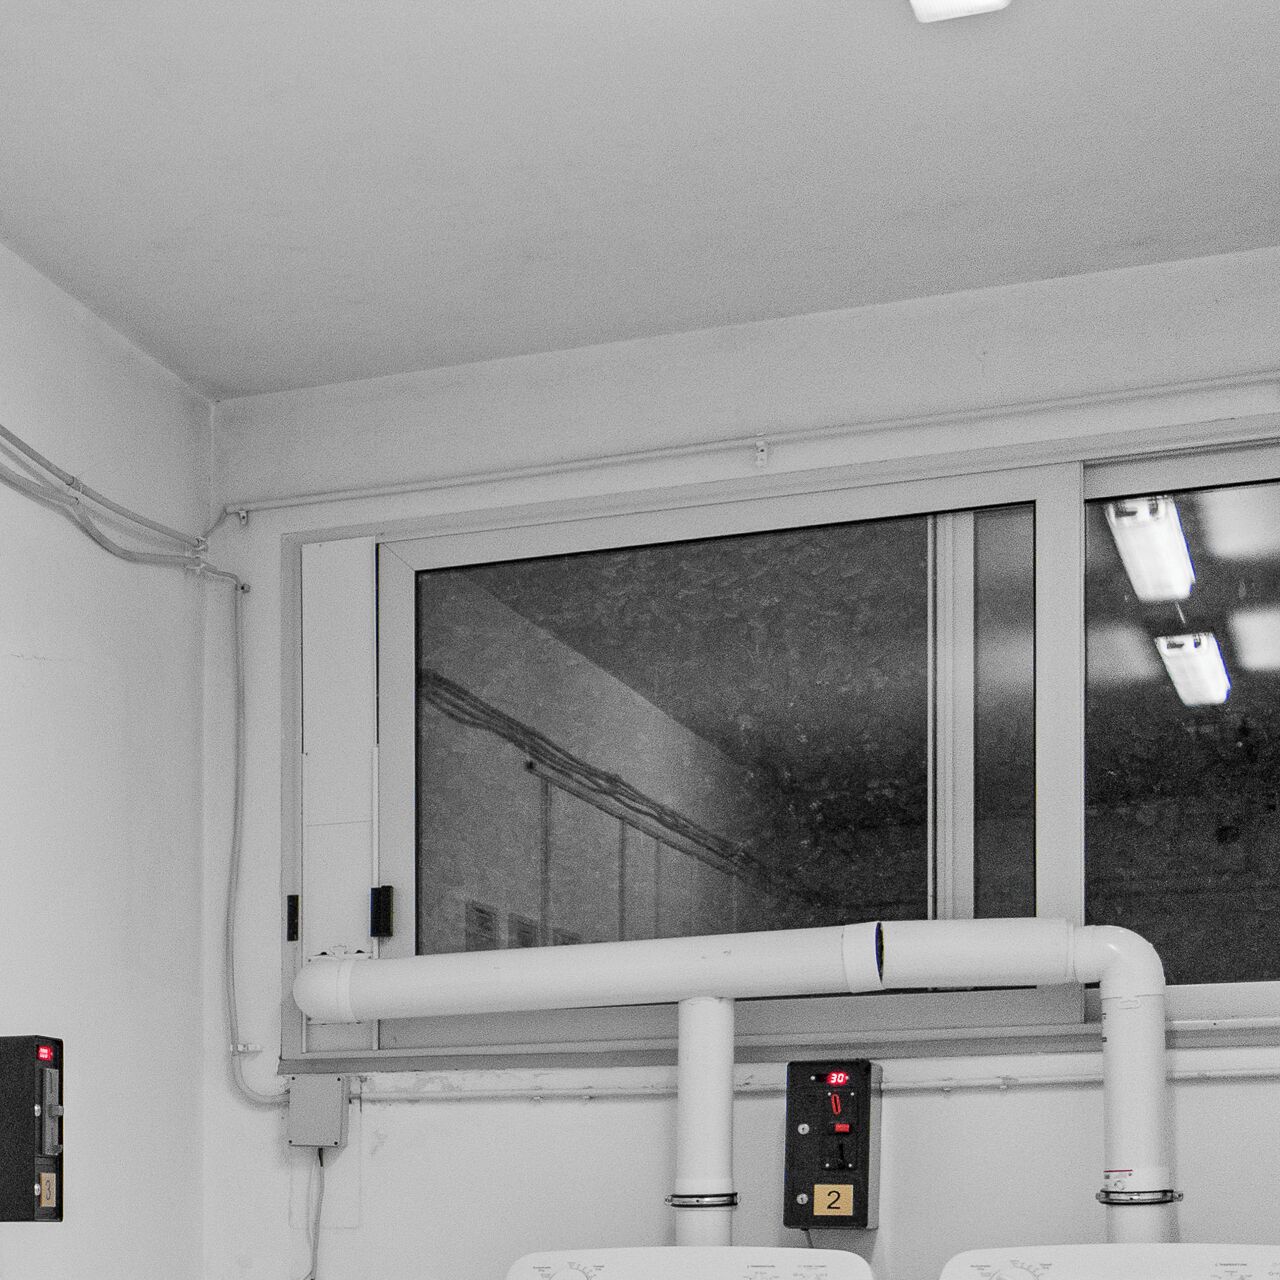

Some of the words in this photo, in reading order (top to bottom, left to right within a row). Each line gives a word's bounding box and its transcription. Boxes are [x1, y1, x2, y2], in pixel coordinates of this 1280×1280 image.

[831, 1073, 845, 1083] 30
[45, 1180, 52, 1200] 3
[826, 1190, 841, 1210] 2
